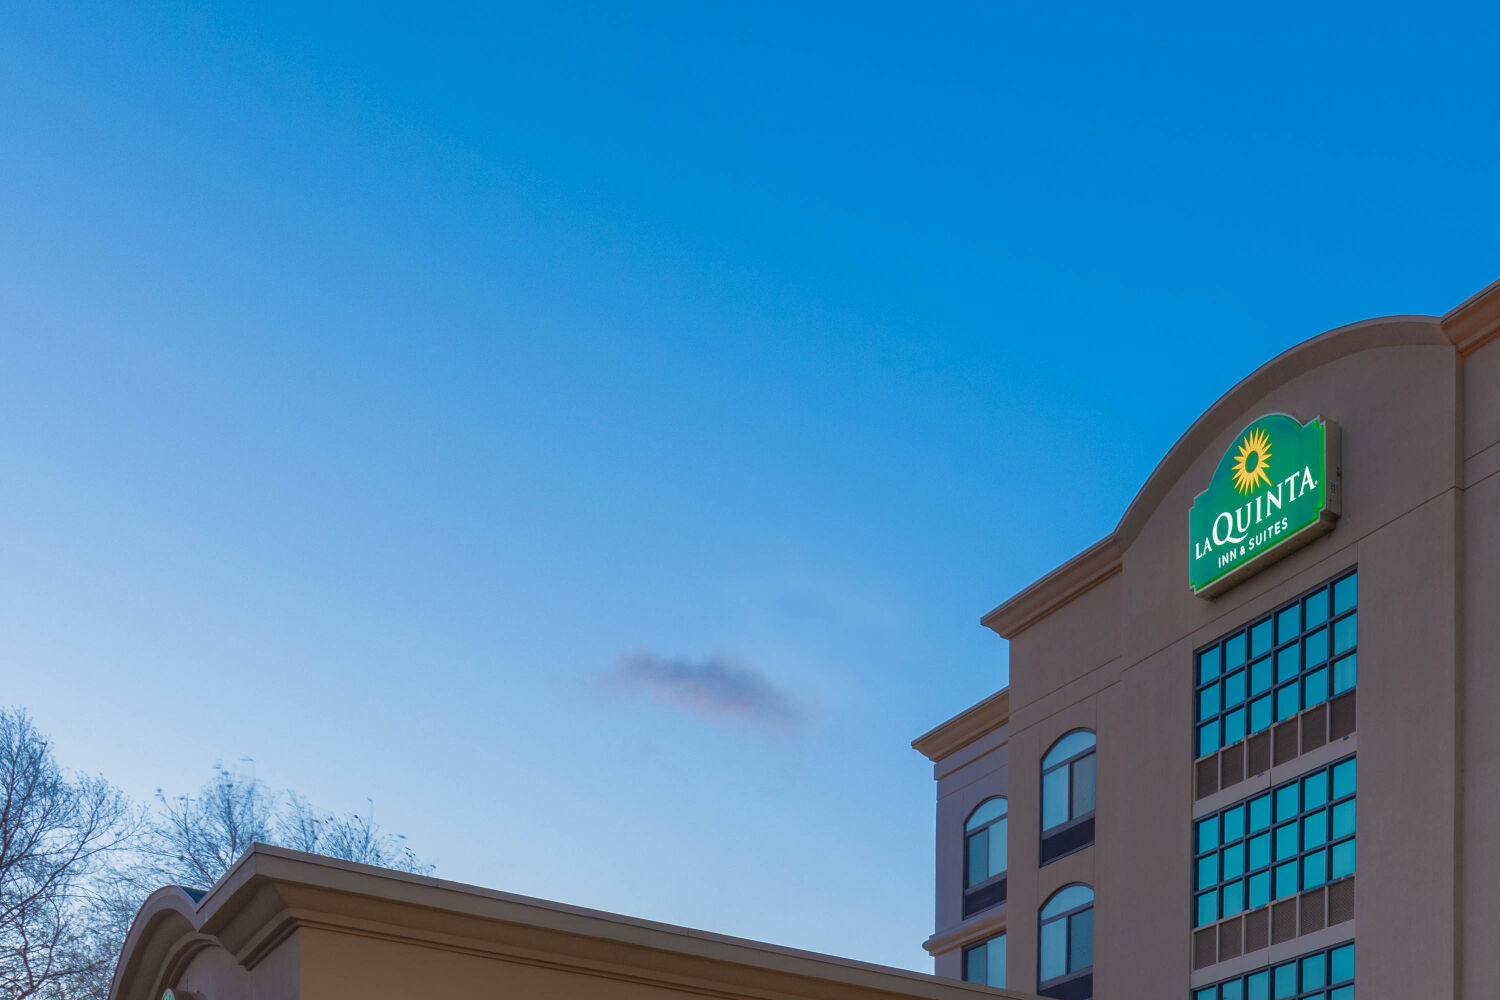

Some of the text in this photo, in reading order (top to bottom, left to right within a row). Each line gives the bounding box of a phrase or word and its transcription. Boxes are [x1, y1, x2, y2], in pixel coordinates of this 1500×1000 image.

[1195, 465, 1318, 560] LA QUINTA
[1218, 517, 1288, 568] INN & SUITES
